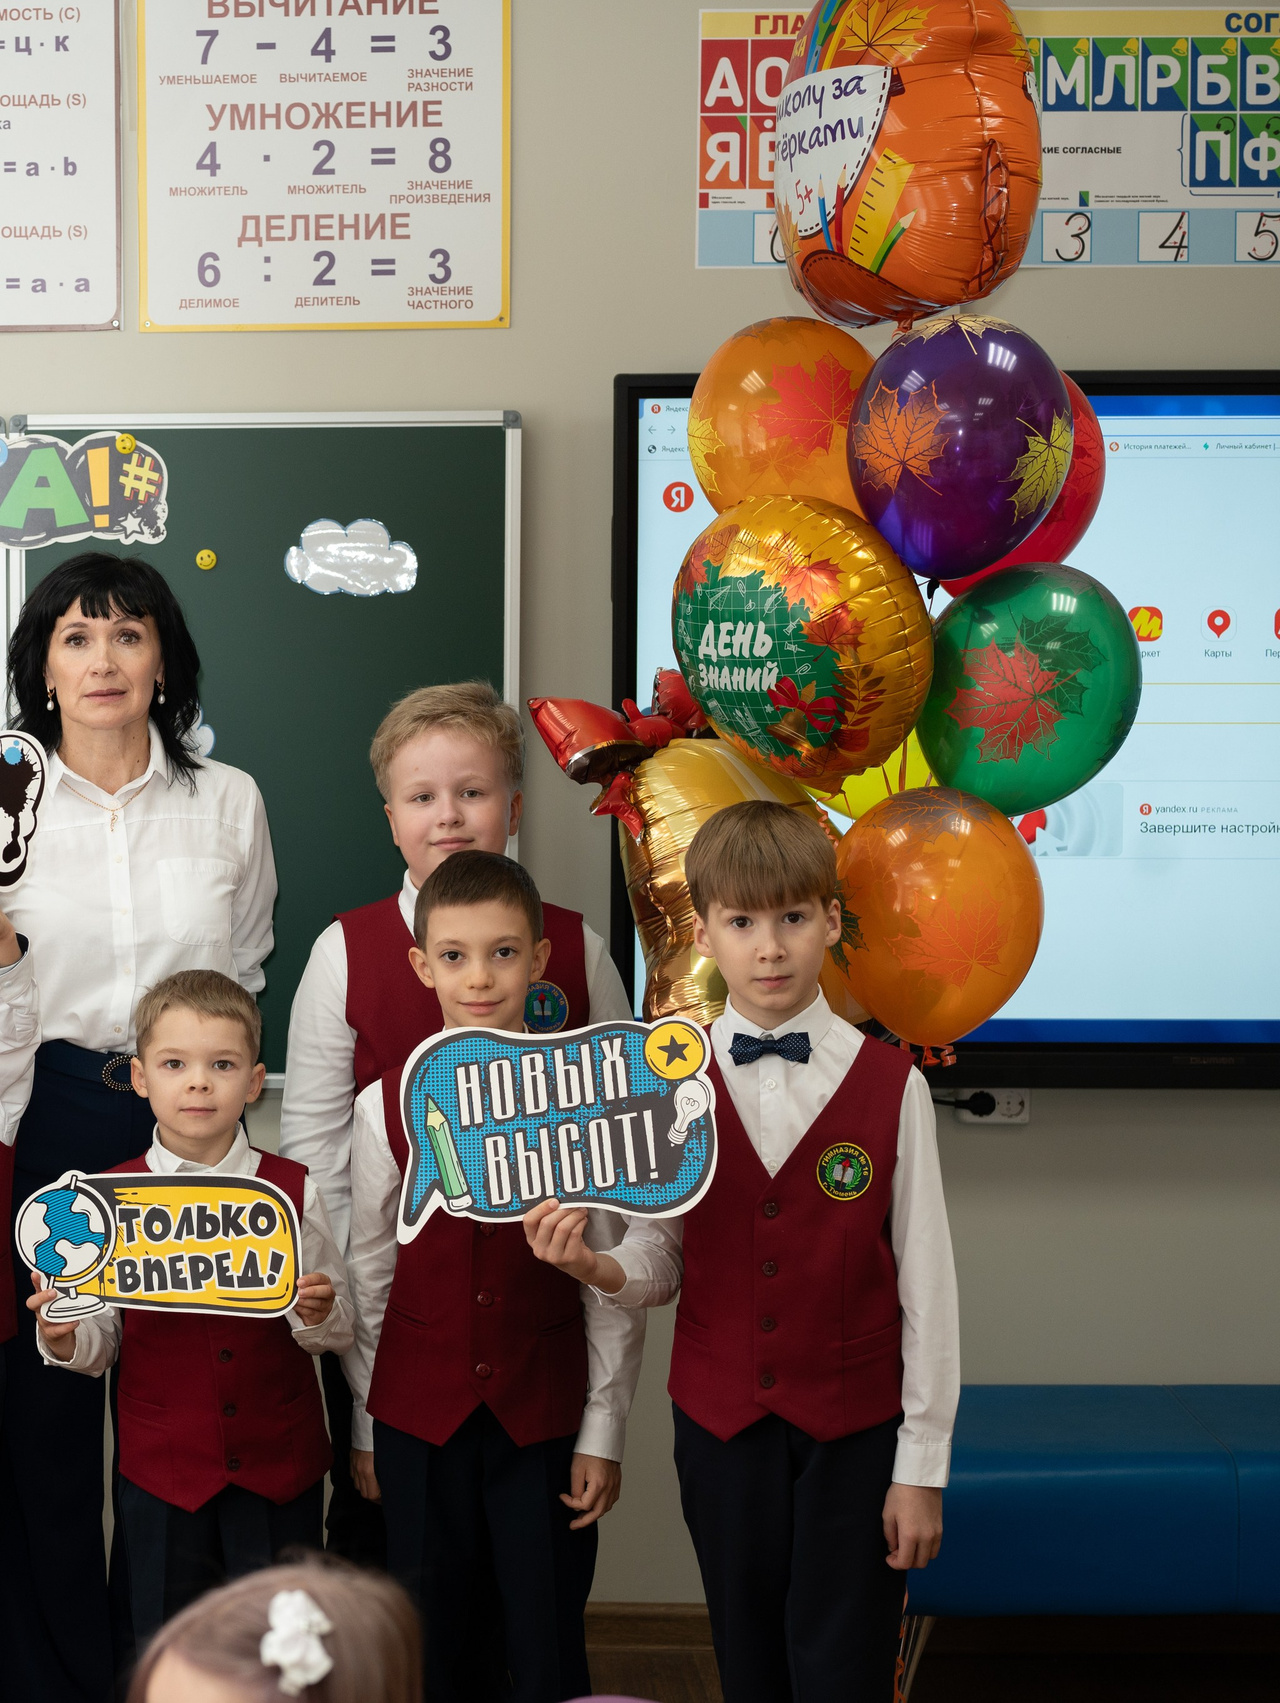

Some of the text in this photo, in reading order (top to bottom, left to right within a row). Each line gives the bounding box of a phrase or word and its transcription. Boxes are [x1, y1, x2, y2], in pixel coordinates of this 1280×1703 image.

[59, 7, 80, 23] (С)
[208, 0, 439, 18] ВЫЧИТАНИЕ
[754, 15, 806, 35] ГЛА
[1225, 12, 1280, 34] СОГ
[196, 30, 219, 65] 7
[311, 27, 336, 63] 4
[429, 25, 452, 61] 3
[159, 74, 257, 85] УМЕНЬШАЕМОЕ
[280, 72, 367, 83] ВЫЧИТАЕМОЕ
[408, 68, 473, 78] ЗНАЧЕНИЕ
[1046, 55, 1280, 105] М Л Р Б В
[408, 82, 473, 92] РАЗНОСТИ
[704, 56, 744, 107] А
[831, 75, 867, 100] за
[67, 94, 86, 109] (S)
[206, 100, 443, 131] УМНОЖЕНИЕ
[775, 116, 865, 172] тёрками
[1062, 146, 1122, 155] СОГЛАСНЫЕ
[196, 142, 221, 177] 4
[312, 140, 335, 175] 2
[429, 137, 451, 173] 8
[705, 131, 741, 182] Я
[1195, 131, 1231, 181] П
[170, 186, 248, 196] МНОЖИТЕЛЬ
[288, 184, 366, 194] МНОЖИТЕЛЬ
[407, 180, 472, 190] ЗНАЧЕНИЕ
[390, 193, 490, 205] ПРОИЗВЕДЕНИЯ
[68, 225, 87, 240] (S)
[238, 213, 411, 247] ДЕЛЕНИЕ
[1055, 211, 1280, 262] 3 4 5
[198, 252, 221, 287] 6
[313, 251, 336, 286] 2
[428, 248, 452, 285] 3
[408, 286, 473, 296] ЗНАЧЕНИЕ
[179, 298, 239, 310] ДЕЛИМОЕ
[295, 296, 360, 308] ДЕЛИТЕЛЬ
[408, 300, 473, 309] ЧАСТНОГО
[665, 405, 689, 413] Яндекс
[1123, 443, 1153, 451] История
[698, 619, 773, 663] ДЕНЬ
[1204, 649, 1232, 659] Карты
[698, 661, 779, 692] ЗНАНИЙ
[1155, 805, 1239, 814] yandex.ru РЕКЛАМА
[1140, 821, 1217, 836] Завершите
[456, 1037, 629, 1127] НОВЫХ
[484, 1109, 659, 1206] ВЫСОТ!
[116, 1202, 279, 1246] ТОЛЬКО
